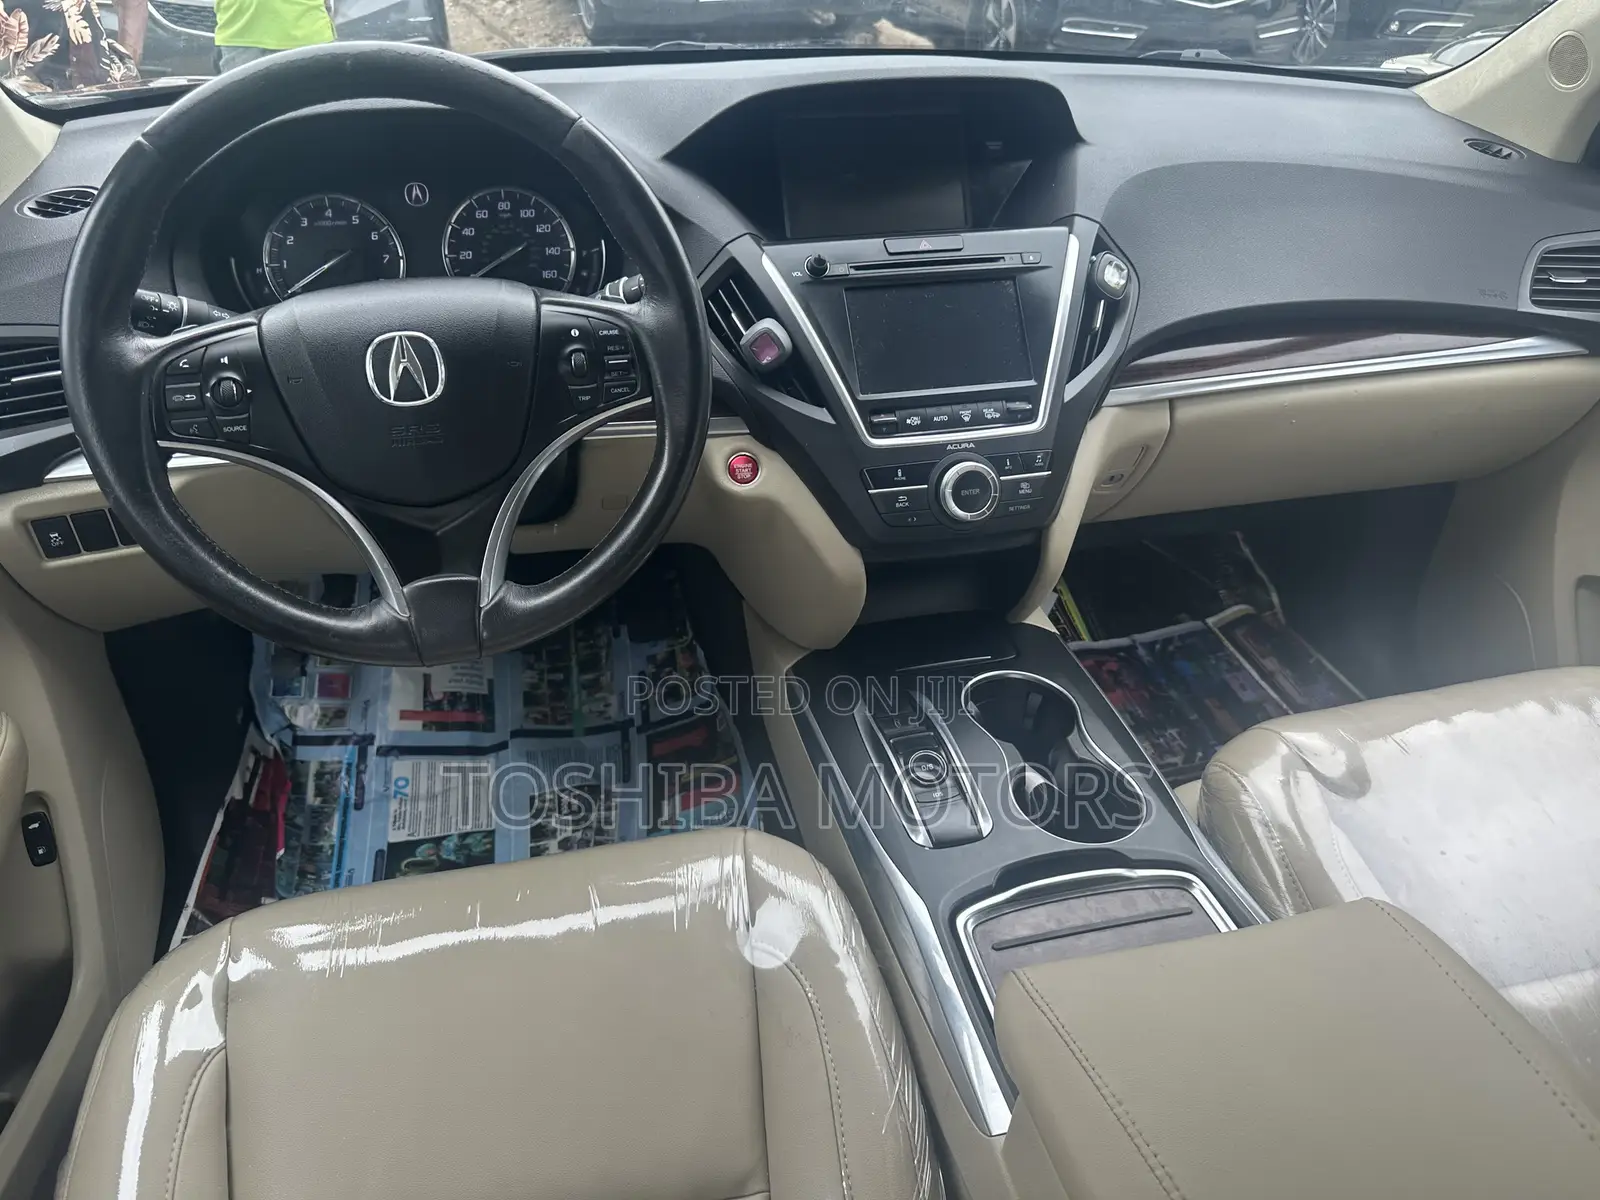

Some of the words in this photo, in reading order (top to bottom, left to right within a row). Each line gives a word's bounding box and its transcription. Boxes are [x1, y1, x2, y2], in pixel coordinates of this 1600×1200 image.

[498, 201, 511, 210] 80
[325, 208, 332, 218] 4
[475, 210, 488, 219] 60
[519, 209, 535, 218] 100
[300, 218, 308, 227] 3
[352, 215, 359, 224] 5
[461, 227, 475, 236] 40
[536, 224, 551, 233] 120
[286, 235, 294, 245] 2
[371, 231, 378, 241] 6
[459, 251, 472, 260] 20
[545, 247, 561, 256] 140
[382, 254, 389, 264] 7
[542, 270, 558, 279] 160
[946, 442, 975, 451] ACURA
[961, 488, 980, 496] ENTER
[393, 776, 410, 800] 70
